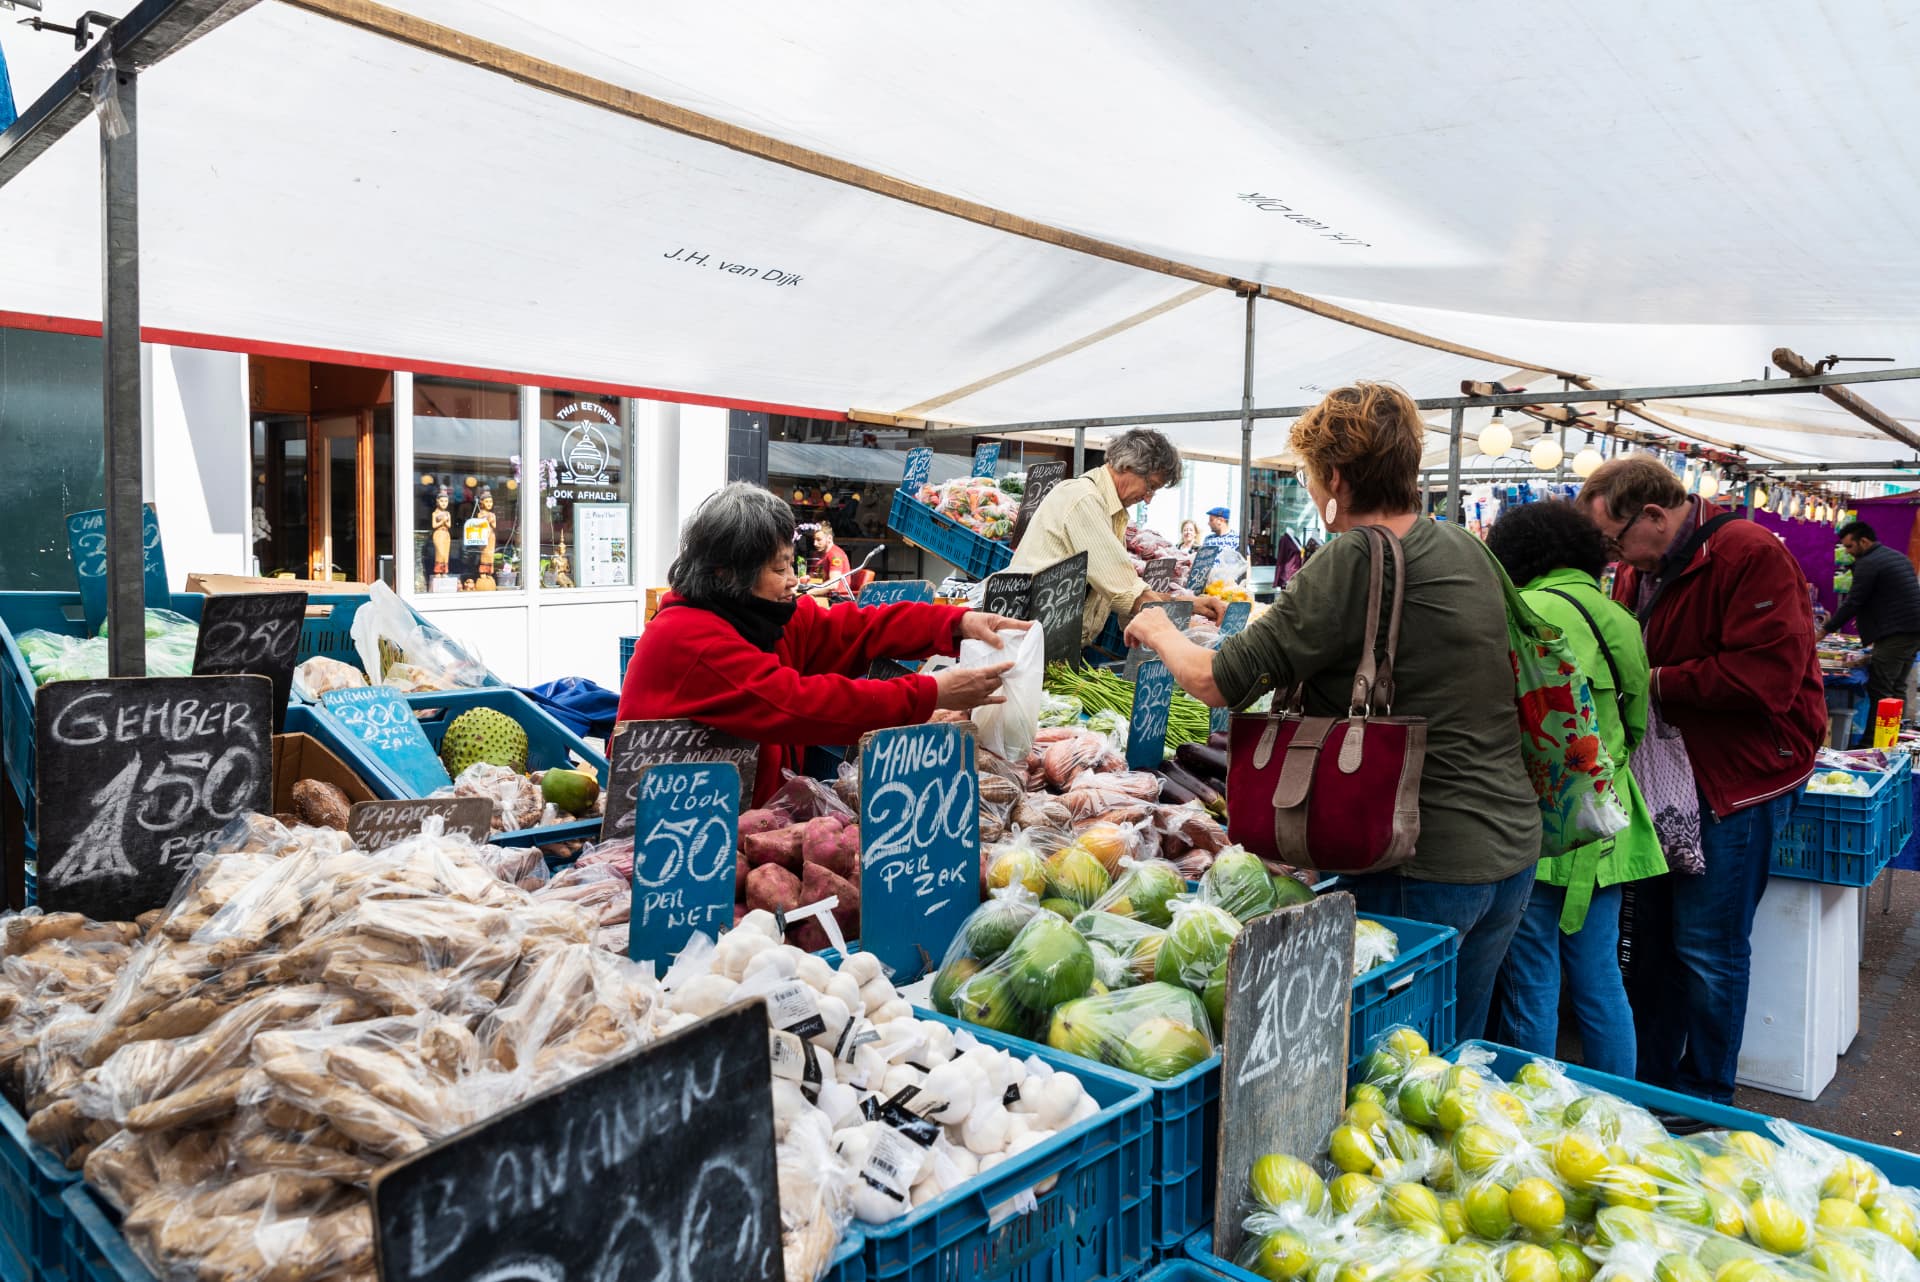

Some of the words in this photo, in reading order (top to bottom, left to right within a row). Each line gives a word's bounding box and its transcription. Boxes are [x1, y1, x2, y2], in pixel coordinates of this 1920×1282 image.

[664, 248, 711, 267] J.H.
[719, 261, 759, 277] van
[761, 269, 804, 287] Dijk
[557, 403, 578, 420] THAI
[580, 401, 617, 426] EETHUIS
[554, 489, 574, 499] OOK
[578, 491, 617, 501] AFHALEN
[861, 588, 907, 604] ZOETE
[199, 618, 300, 665] 250
[51, 692, 258, 746] GEMBER
[628, 726, 711, 749] WITTE
[615, 750, 678, 773] ZOETE
[870, 732, 955, 784] MANGO
[641, 771, 711, 800] KNOF
[669, 789, 732, 813] LOOK
[47, 745, 260, 890] 150
[880, 853, 931, 894] PER
[912, 859, 968, 898] ZAK
[642, 888, 685, 928] PER
[667, 902, 729, 929] NET
[1238, 917, 1345, 994] LIMOENEN
[408, 1051, 725, 1278] BANANEN
